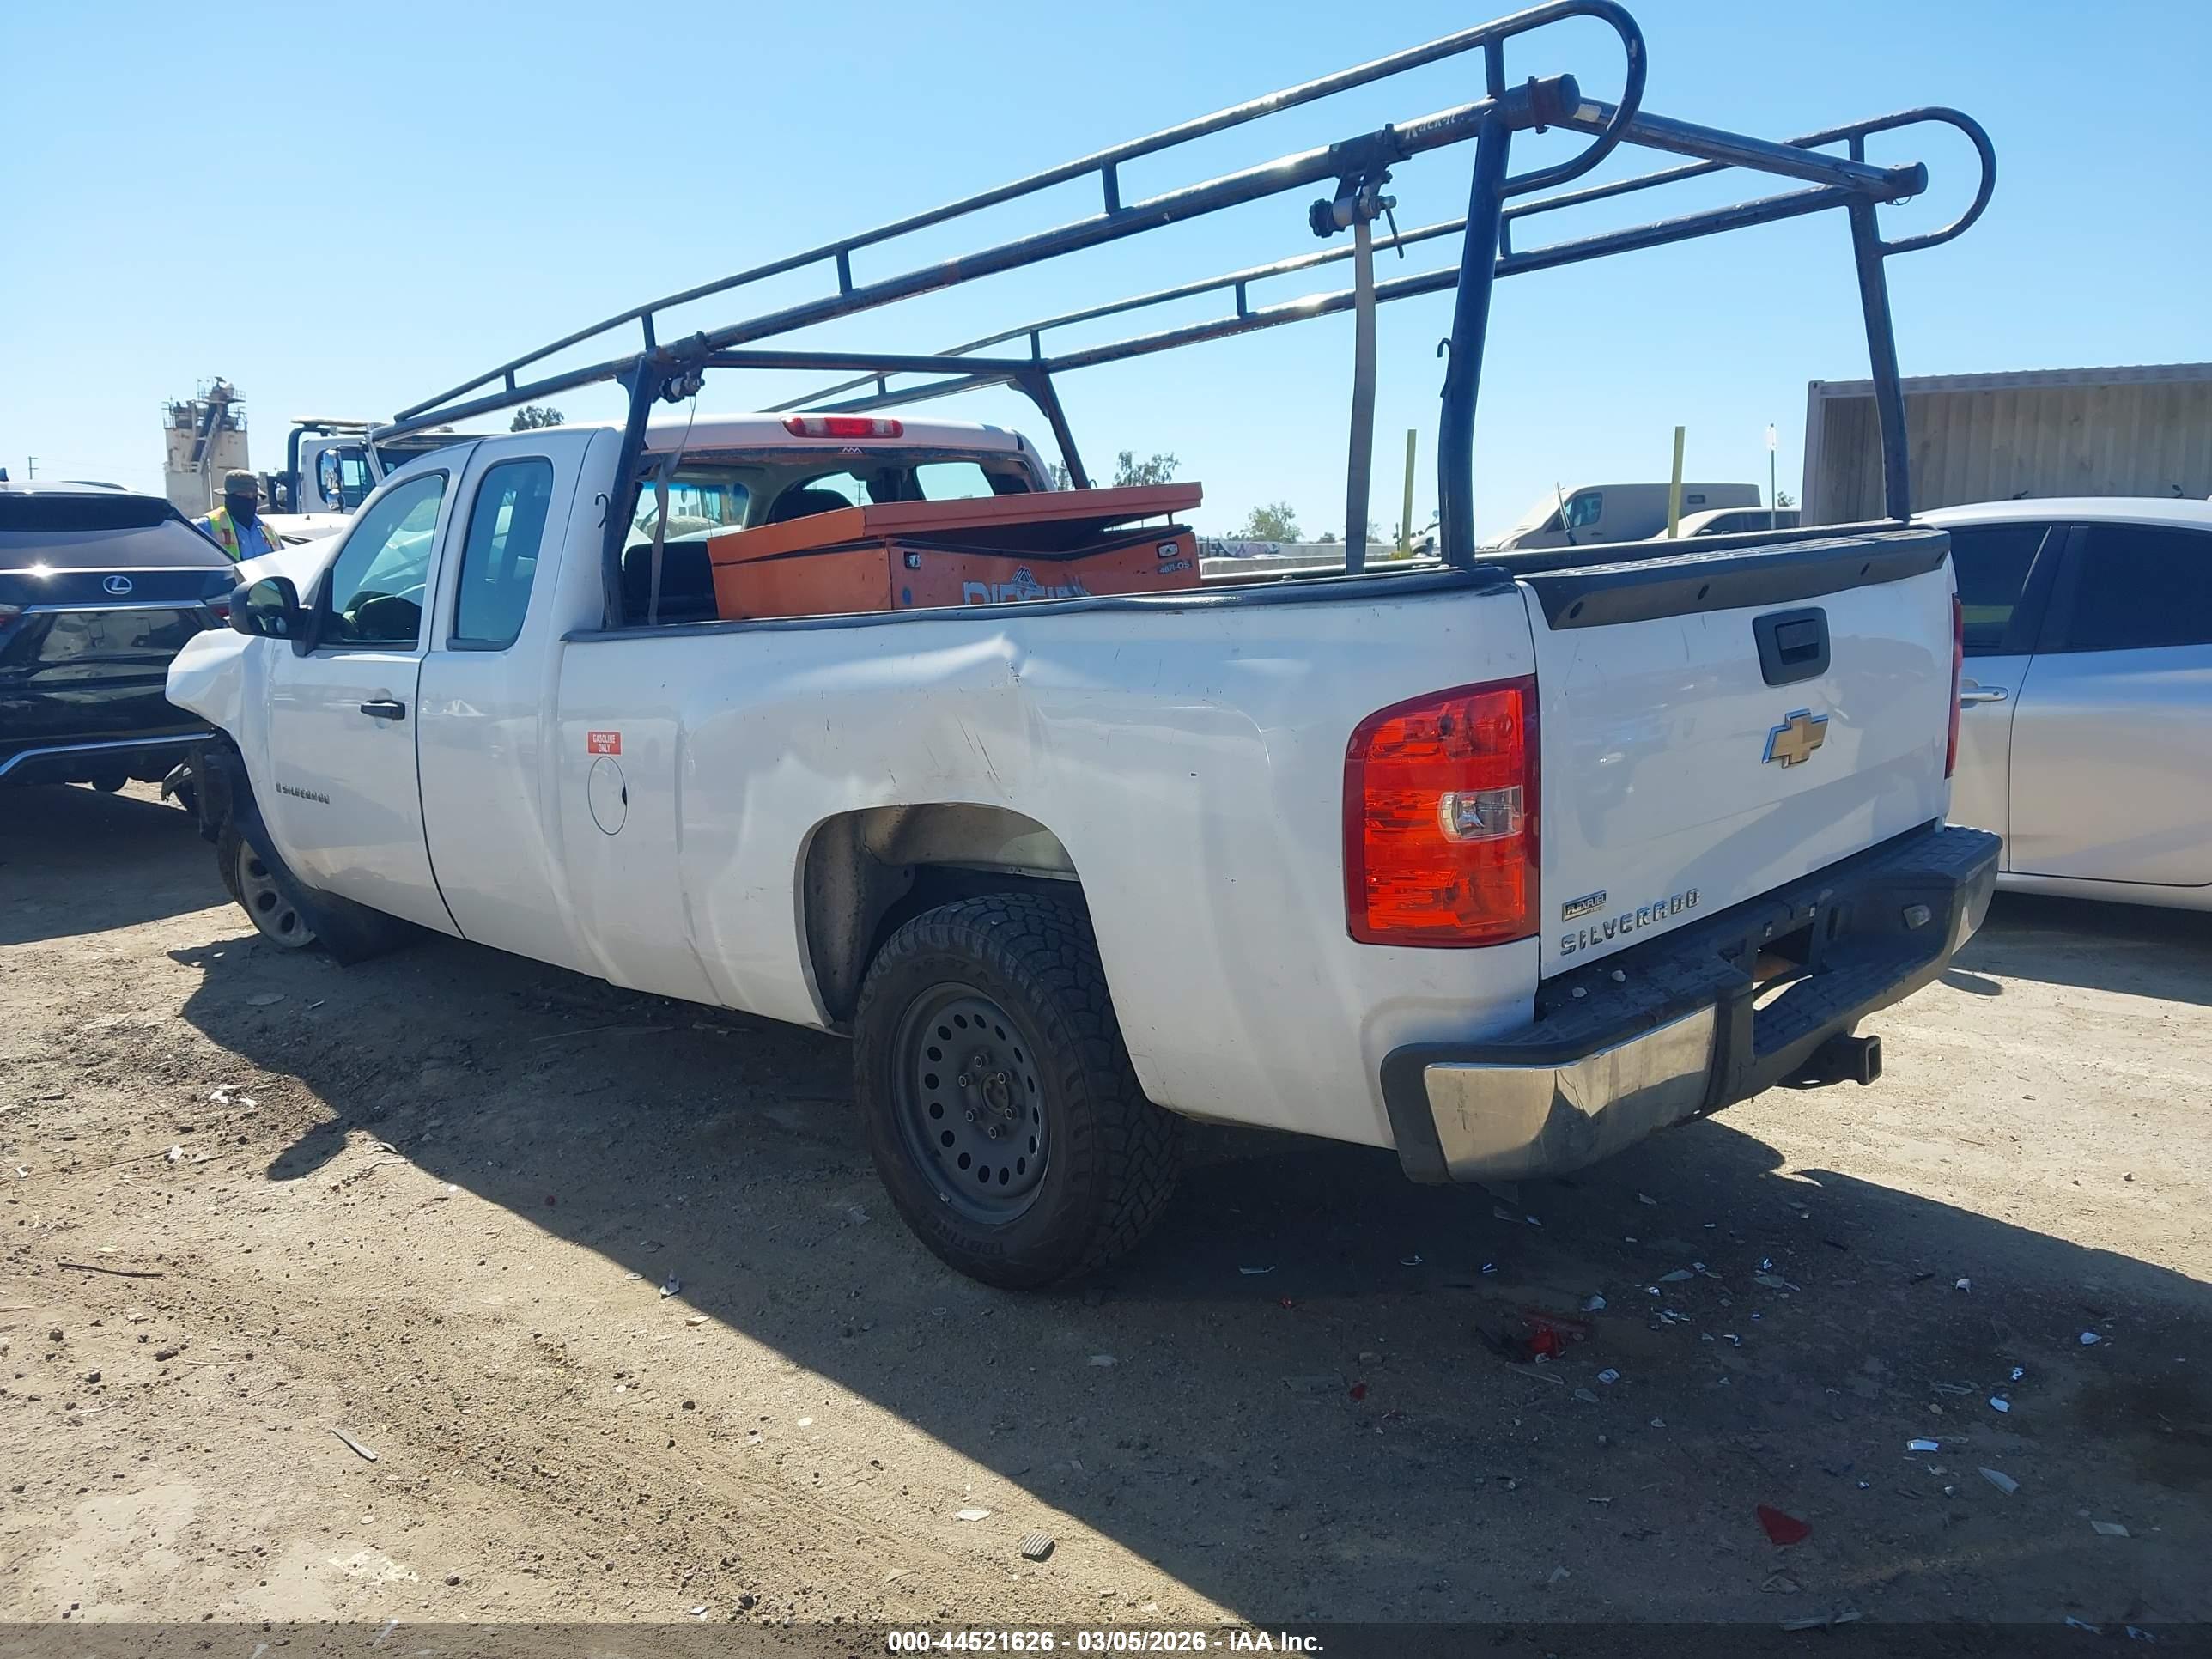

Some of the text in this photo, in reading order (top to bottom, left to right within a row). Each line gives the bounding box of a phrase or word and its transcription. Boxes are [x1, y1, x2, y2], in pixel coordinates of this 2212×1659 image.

[592, 734, 617, 744] GASOLINE
[598, 744, 611, 753] ONLY
[1560, 888, 1700, 957] SILVERADO
